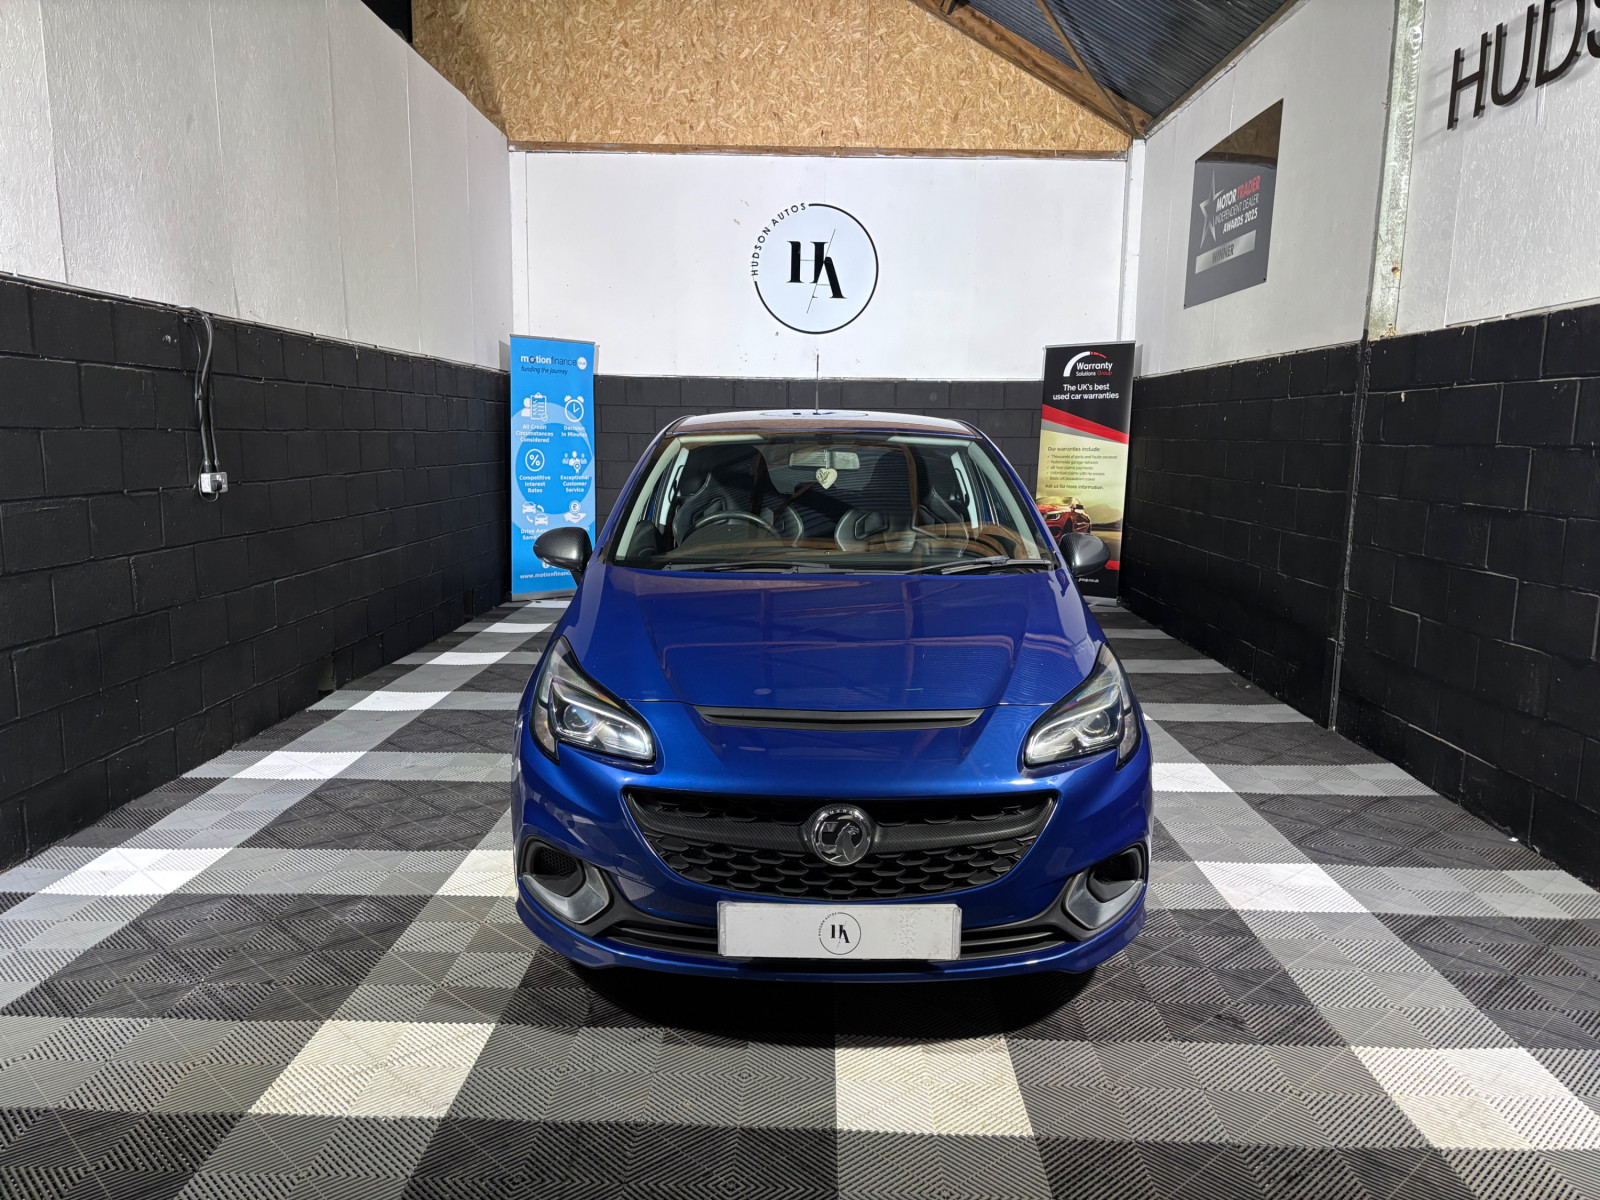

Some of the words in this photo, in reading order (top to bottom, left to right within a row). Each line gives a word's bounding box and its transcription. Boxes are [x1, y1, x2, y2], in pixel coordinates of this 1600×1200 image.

[1447, 0, 1600, 130] HUD
[1215, 201, 1242, 224] INDEPENDENT
[1242, 193, 1259, 211] DEALER
[1223, 214, 1244, 234] AWARDS
[1244, 207, 1258, 223] 2025
[751, 226, 771, 276] HUDSON
[771, 202, 806, 227] AUTOS
[1212, 243, 1235, 264] WINNER
[521, 365, 540, 374] funding
[549, 368, 568, 376] journey
[1076, 361, 1113, 371] Warranty
[1078, 383, 1093, 391] UK's
[1082, 392, 1119, 400] warranties
